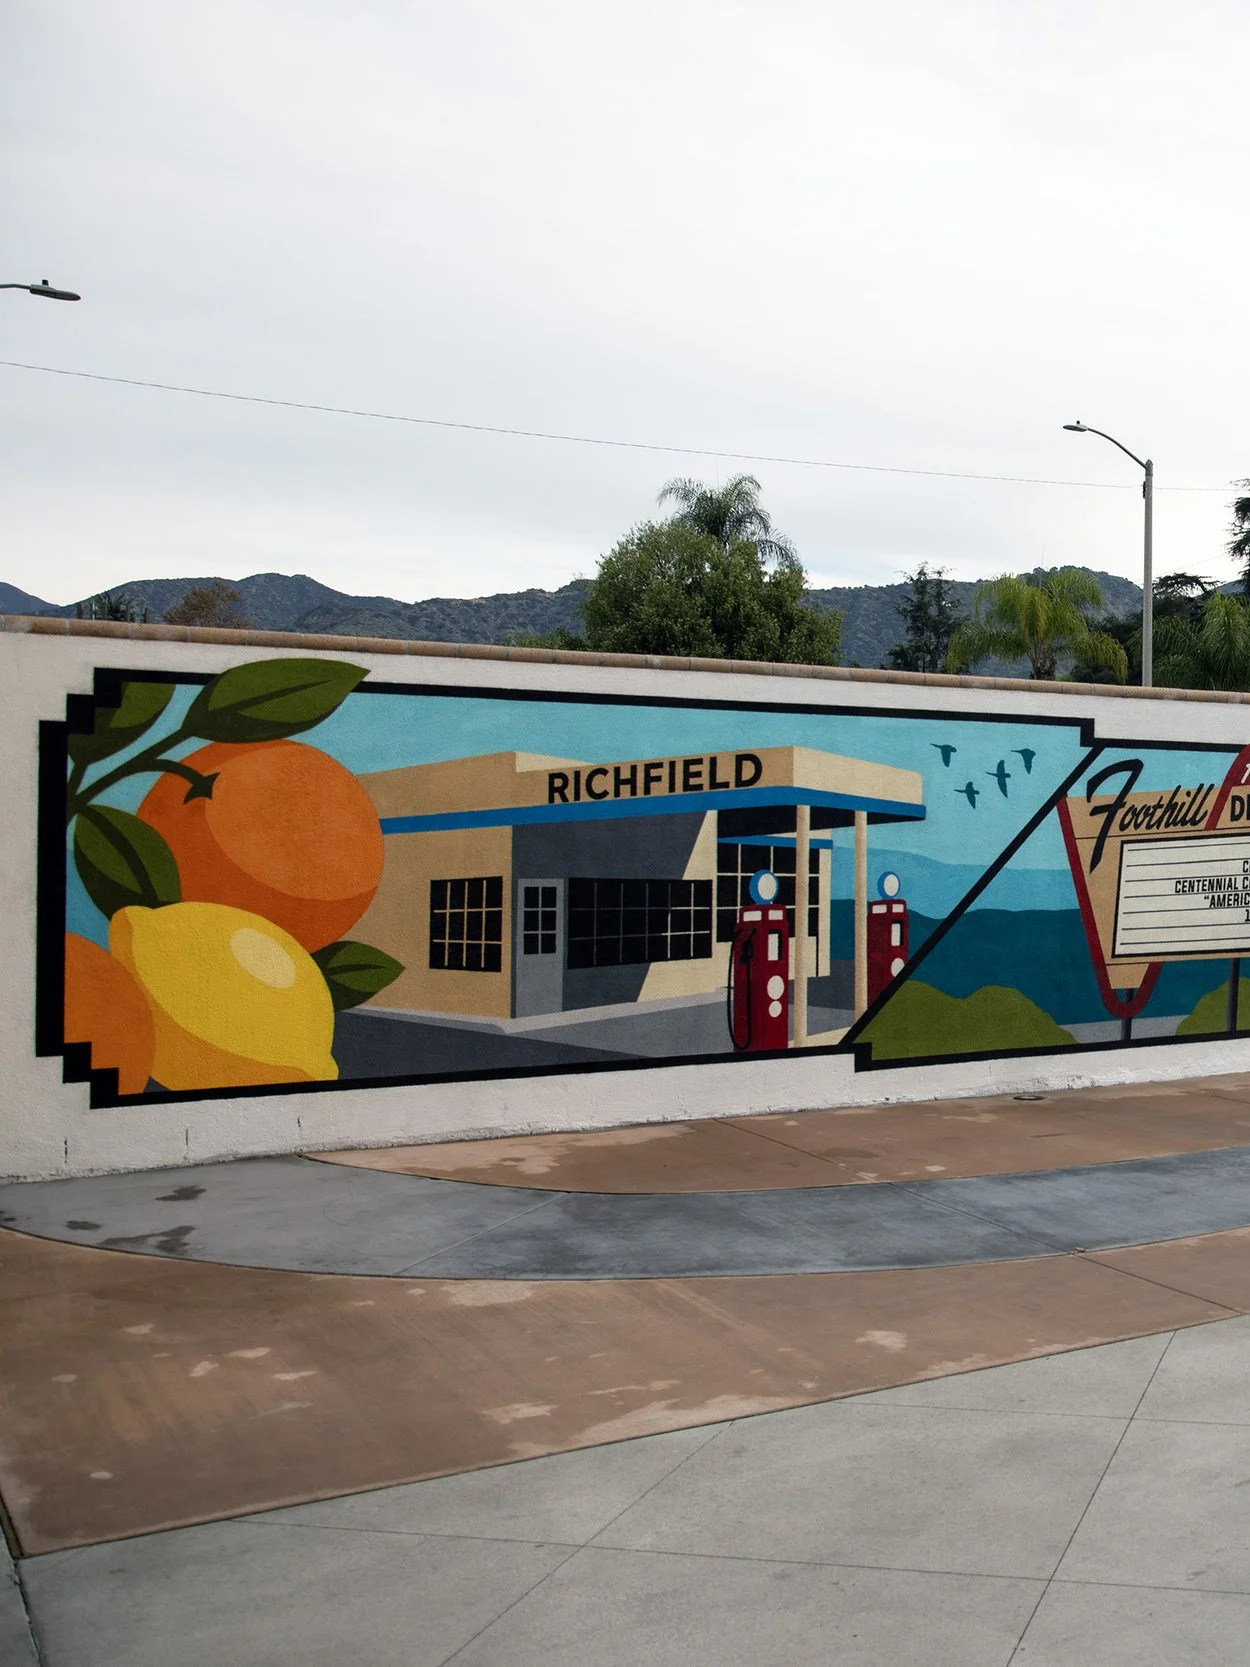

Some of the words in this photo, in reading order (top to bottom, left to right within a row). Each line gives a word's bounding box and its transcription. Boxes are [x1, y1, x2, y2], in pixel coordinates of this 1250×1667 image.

[547, 753, 763, 804] RICHFIELD
[1086, 758, 1215, 875] Foothill
[1174, 876, 1239, 894] CENTENNIAL
